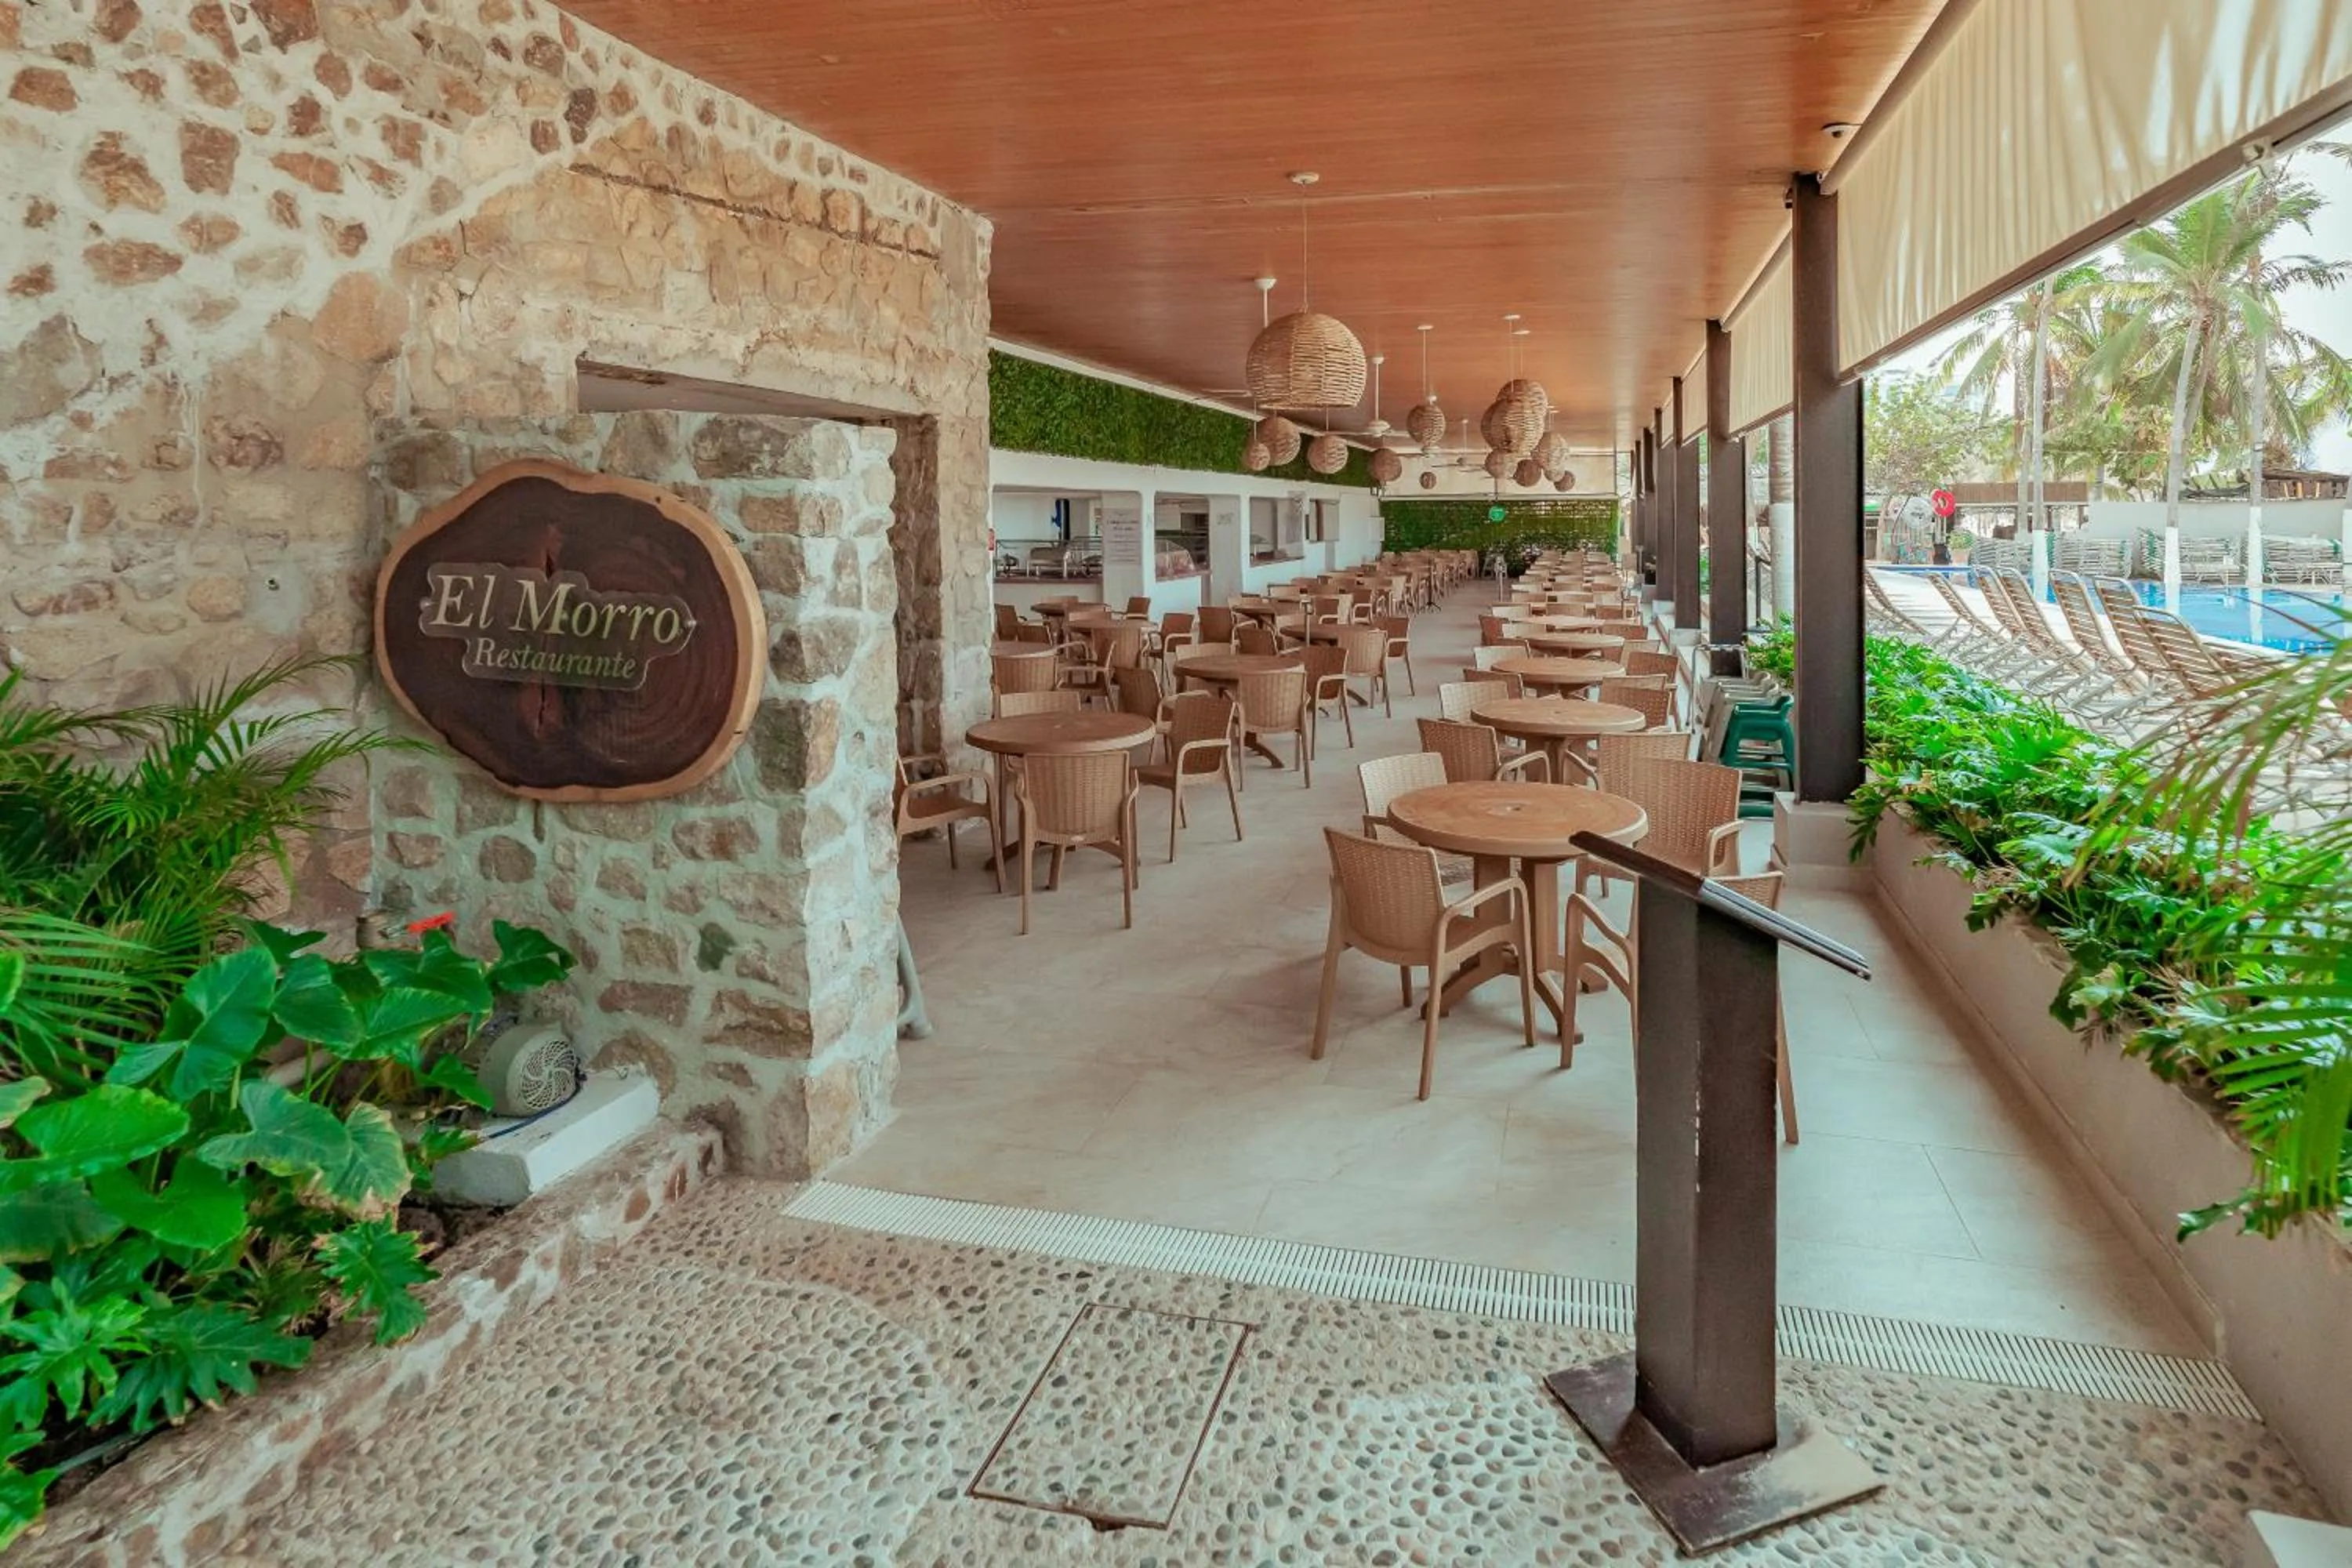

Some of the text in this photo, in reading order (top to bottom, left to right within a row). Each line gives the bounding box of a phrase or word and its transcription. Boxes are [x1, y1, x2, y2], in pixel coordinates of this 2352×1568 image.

[429, 574, 681, 644] El Morro
[473, 637, 637, 679] Restaurante
